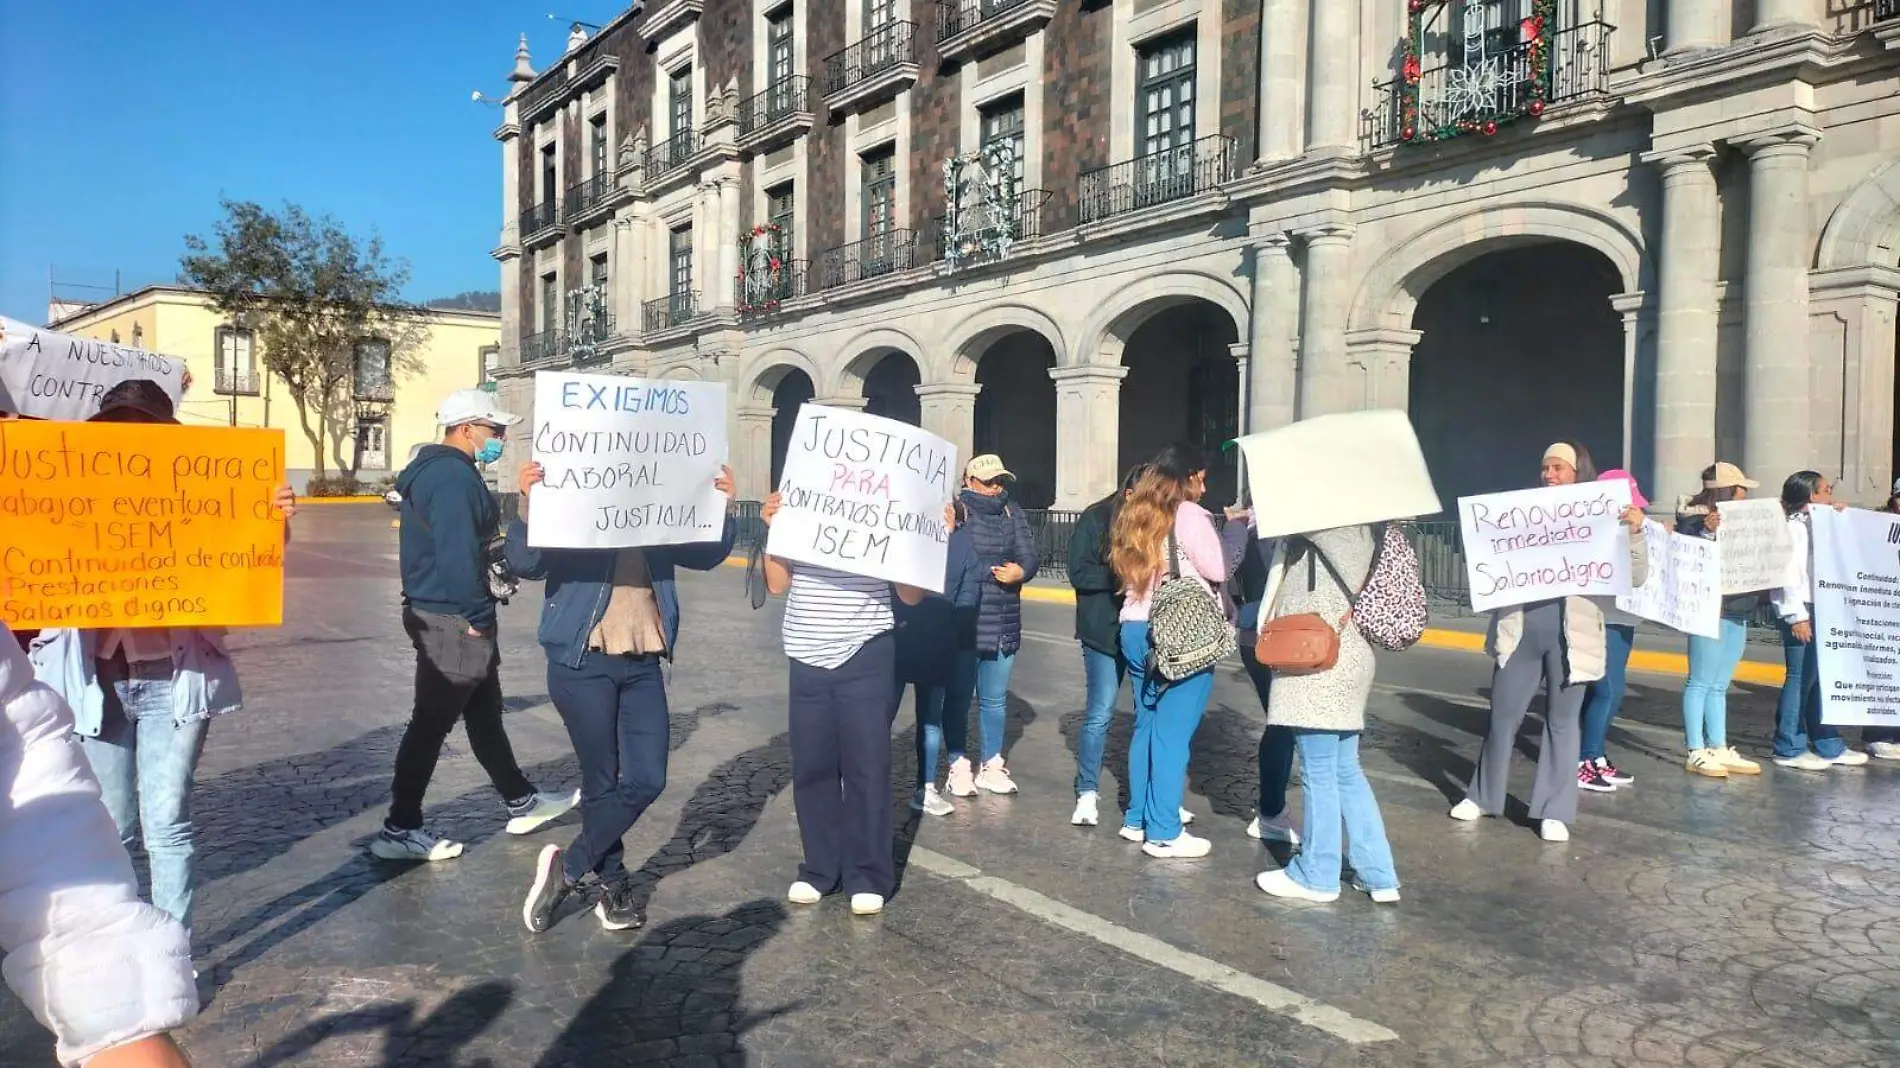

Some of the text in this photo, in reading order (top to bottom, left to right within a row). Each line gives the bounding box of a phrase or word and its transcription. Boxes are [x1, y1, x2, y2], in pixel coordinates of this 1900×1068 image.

[27, 333, 172, 375] A NUESTROS
[30, 374, 105, 405] CONTR
[562, 381, 689, 414] EXIGIMOS
[535, 421, 706, 457] CONTINUIDAD
[804, 415, 947, 493] JUSTICIA
[172, 454, 243, 492] para
[252, 447, 278, 482] el
[542, 461, 663, 490] LABORAL
[829, 463, 892, 499] PARA
[0, 488, 97, 525] abajor
[113, 487, 236, 520] eventual
[1470, 493, 1620, 533] Renovación
[813, 523, 891, 564] ISEM
[1491, 521, 1592, 552] inmediata
[4, 546, 177, 577] Continuidad
[186, 547, 213, 568] de
[1558, 556, 1613, 587] digno
[8, 575, 179, 599] Prestaciones
[4, 597, 207, 623] Salarios dignos
